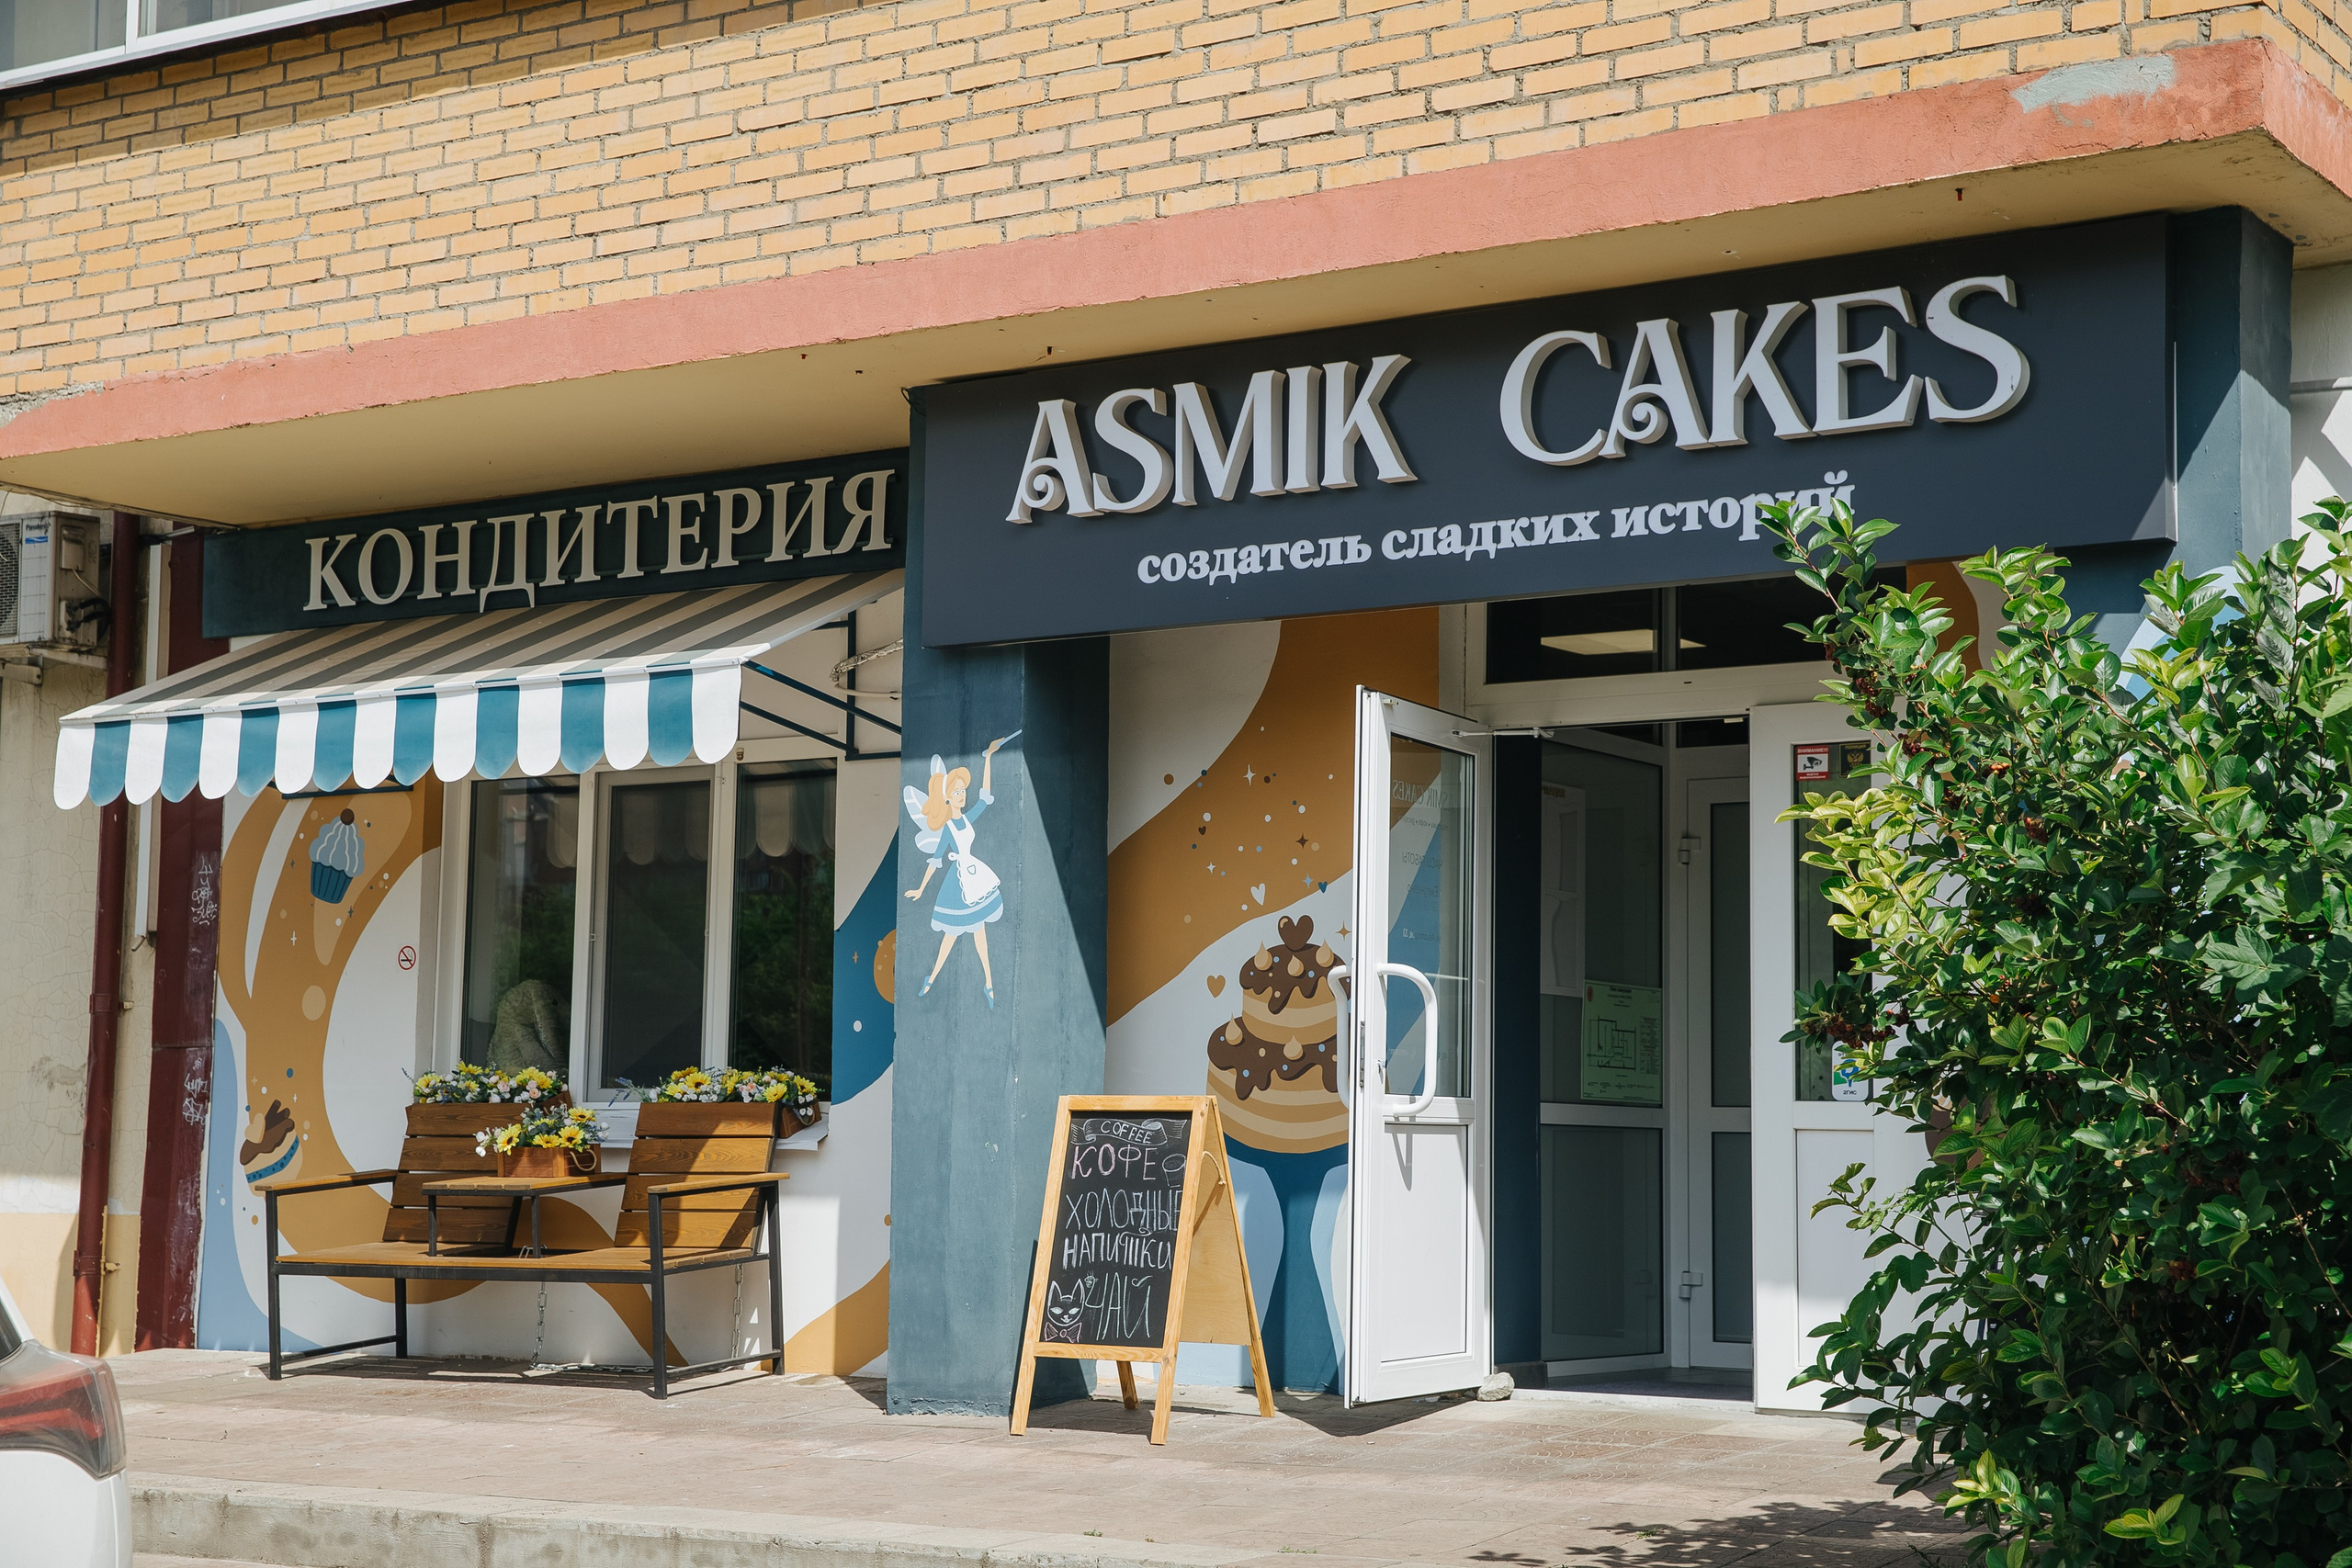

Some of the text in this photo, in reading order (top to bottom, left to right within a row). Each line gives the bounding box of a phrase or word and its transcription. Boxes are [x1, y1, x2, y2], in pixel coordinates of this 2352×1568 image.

[1005, 275, 2030, 524] ASMIK CAKES
[302, 468, 895, 613] КОНДИТЕРИЯ
[1137, 535, 1372, 585] создатель
[1381, 510, 1600, 560] сладких
[1070, 1143, 1157, 1180] КОФЕ
[1101, 1121, 1151, 1144] COFFEE
[1066, 1188, 1182, 1231] ХОЛОДНЫЕ
[1085, 1272, 1153, 1340] ЧАЙ
